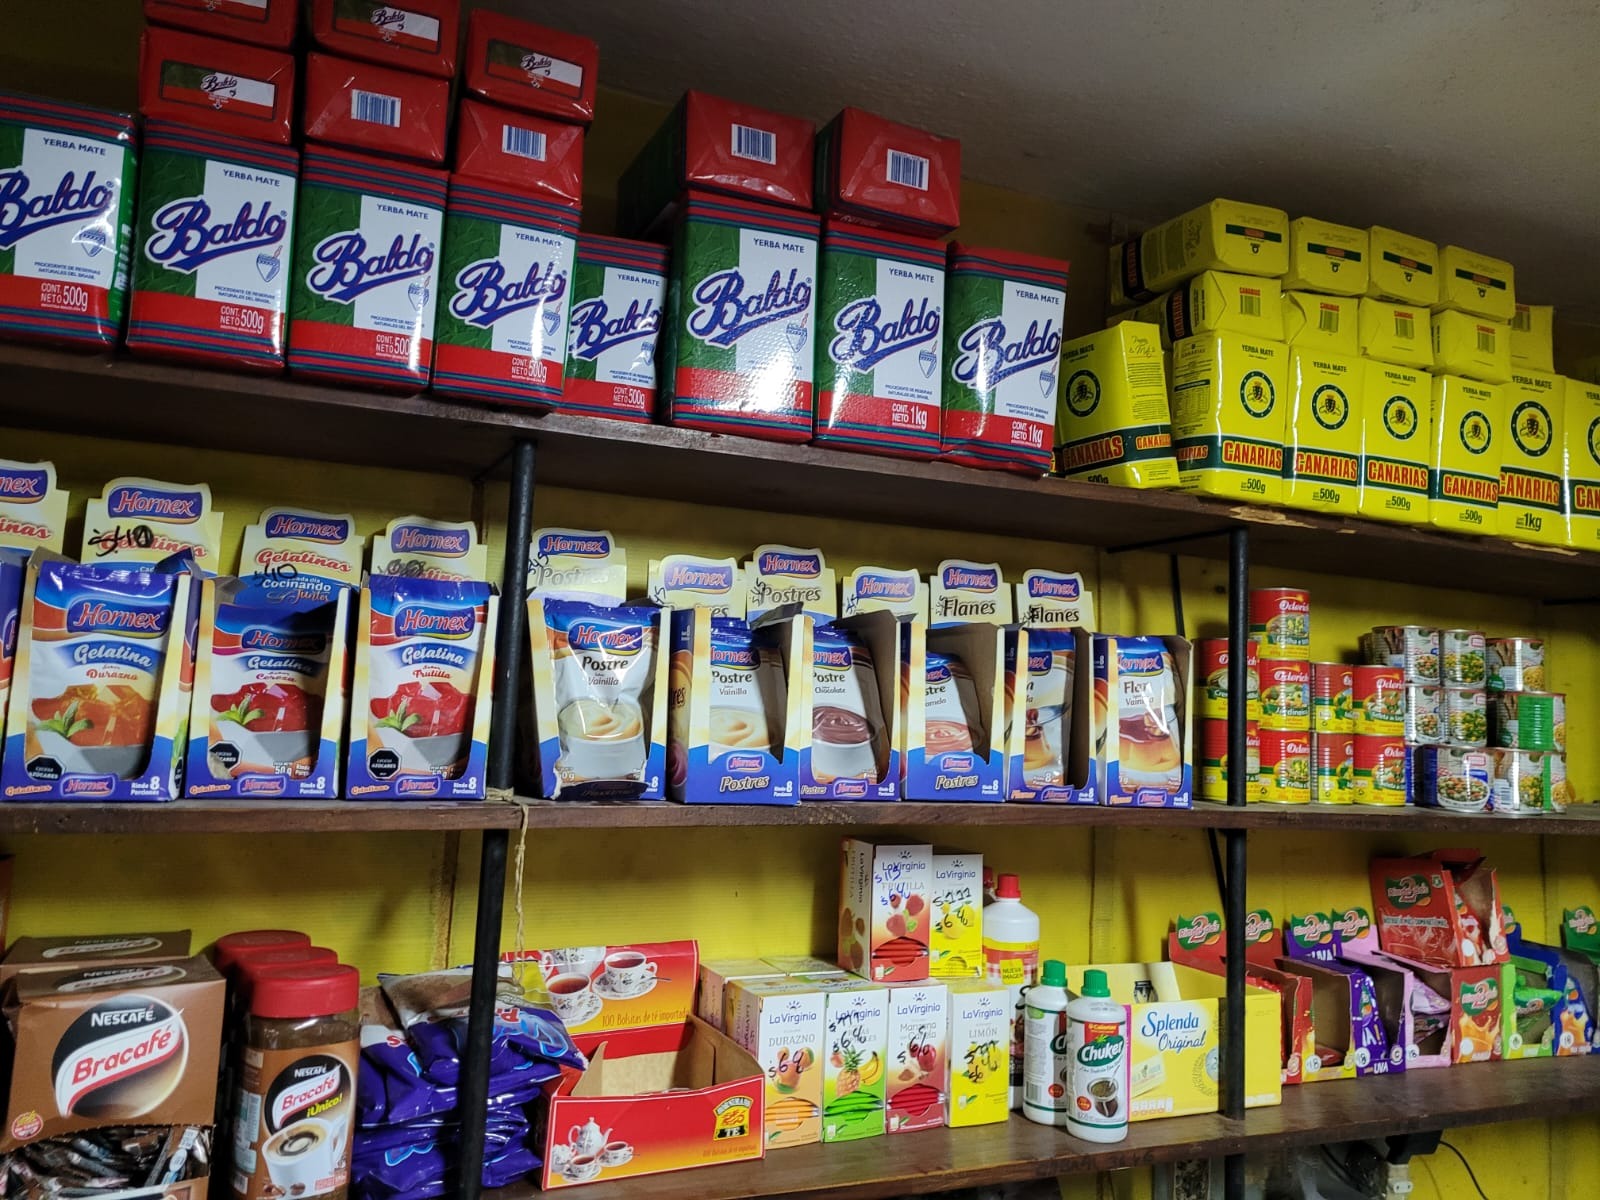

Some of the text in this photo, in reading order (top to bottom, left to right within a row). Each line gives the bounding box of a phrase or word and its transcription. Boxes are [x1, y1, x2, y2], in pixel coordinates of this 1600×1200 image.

[43, 138, 106, 156] YERBA MATE
[223, 169, 280, 187] YERBA MATE
[0, 170, 114, 247] Baldo
[377, 204, 429, 220] YERBA MATE
[149, 199, 287, 271] Baldo
[515, 232, 541, 243] YERBA
[753, 237, 805, 254] YERBA MATE
[309, 233, 433, 300] Baldo
[889, 268, 934, 283] YERBA MATE
[617, 274, 660, 286] YERBA MATE
[41, 285, 88, 312] NETO 500g
[452, 261, 566, 326] Baldo
[1015, 288, 1059, 305] YERBA MATE
[690, 268, 811, 346] Baldo
[221, 309, 264, 334] NETO 500g
[570, 299, 662, 360] Baldo
[832, 298, 940, 371] Baldo
[376, 344, 393, 354] NETO
[955, 318, 1061, 390] Baldo
[1242, 344, 1274, 357] YERBA MATE
[512, 366, 528, 375] NETO
[1313, 361, 1347, 373] YERBA MATE
[1384, 371, 1417, 383] YERBA MATE
[1511, 375, 1553, 390] YERBA MATE
[613, 388, 645, 409] NETO 500g
[1462, 386, 1491, 399] YERBA MATE
[892, 406, 927, 430] NETO 1kg
[1012, 424, 1043, 448] NETO 1kg
[1064, 435, 1124, 470] CANARIAS
[1222, 440, 1283, 471] CANARIAS
[1295, 452, 1357, 481] CANARIAS
[1367, 461, 1427, 488] CANARIAS
[1247, 478, 1266, 494] 500g
[1319, 488, 1340, 503] 500g
[1443, 475, 1498, 502] CANARIAS
[1500, 475, 1559, 506] CANARIAS
[113, 490, 196, 517] Hornex
[1391, 496, 1411, 511] 500g
[1464, 510, 1482, 524] 500g
[1524, 513, 1542, 531] 1kg
[270, 517, 343, 540] Hornex
[396, 529, 464, 551] Hornex
[544, 537, 605, 553] Hornex
[257, 548, 352, 573] Gelatinas
[763, 555, 817, 573] Hornex
[262, 579, 332, 592] Cocinando
[538, 566, 609, 587] Postres
[669, 566, 728, 587] Hornex
[946, 569, 995, 588] Hornex
[762, 586, 821, 604] Postres
[859, 577, 911, 596] Hornex
[1031, 577, 1077, 597] Hornex
[73, 603, 161, 630] Hornex
[943, 598, 996, 618] Flanes
[1031, 608, 1080, 623] Flanes
[401, 609, 470, 632] Hornex
[248, 630, 319, 649] Hornex
[575, 626, 638, 648] Hornex
[74, 644, 152, 667] Gelatina
[248, 656, 313, 673] Gelatina
[402, 648, 465, 665] Gelatina
[582, 656, 629, 673] Postre
[86, 669, 139, 681] Durazno
[413, 669, 452, 680] Frutilla
[150, 776, 160, 790] 8
[316, 776, 325, 790] 8
[469, 777, 477, 789] 8
[720, 776, 769, 792] Postres
[936, 775, 978, 791] Postres
[91, 1005, 156, 1027] NESCAFÉ
[602, 1015, 615, 1027] 100
[617, 1012, 642, 1025] Bolsitas
[643, 1011, 651, 1021] de
[1142, 1011, 1199, 1037] Splenda
[768, 1033, 816, 1047] DURAZNO
[969, 1026, 998, 1038] LIMÓN
[1158, 1030, 1206, 1053] Original
[72, 1025, 172, 1085] Bracafé
[1081, 1041, 1122, 1062] Chuker
[294, 1064, 327, 1078] NESCAFÉ
[1373, 1061, 1388, 1074] UVA
[281, 1073, 337, 1111] Bracafé
[306, 1094, 343, 1118] ¡Único!
